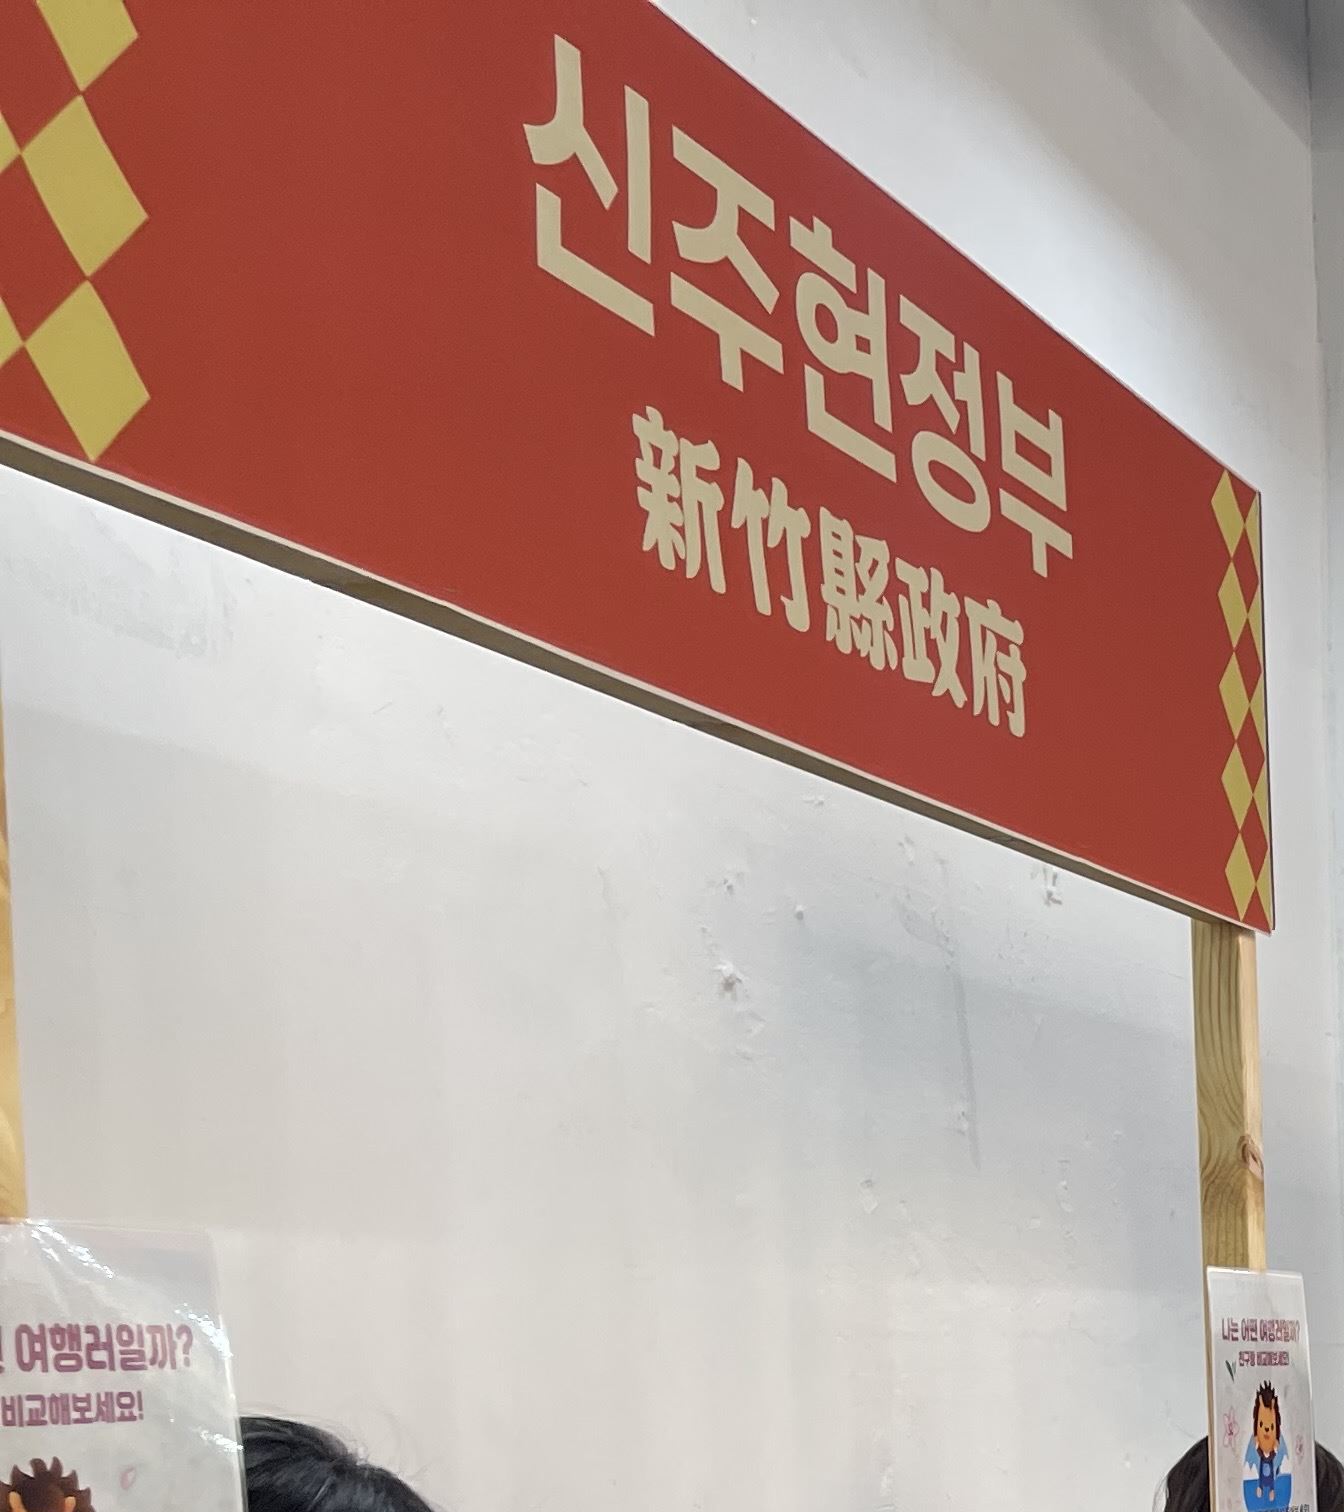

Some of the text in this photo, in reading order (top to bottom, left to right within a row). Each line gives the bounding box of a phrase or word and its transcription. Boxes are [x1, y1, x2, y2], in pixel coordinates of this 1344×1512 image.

[522, 34, 1073, 578] 신주현정부
[631, 405, 1029, 738] 新竹縣政府
[15, 1324, 193, 1373] 여행러일까?
[1222, 1317, 1239, 1341] 나는
[1241, 1318, 1258, 1341] 어떤
[2, 1391, 143, 1427] 비교해보세요!
